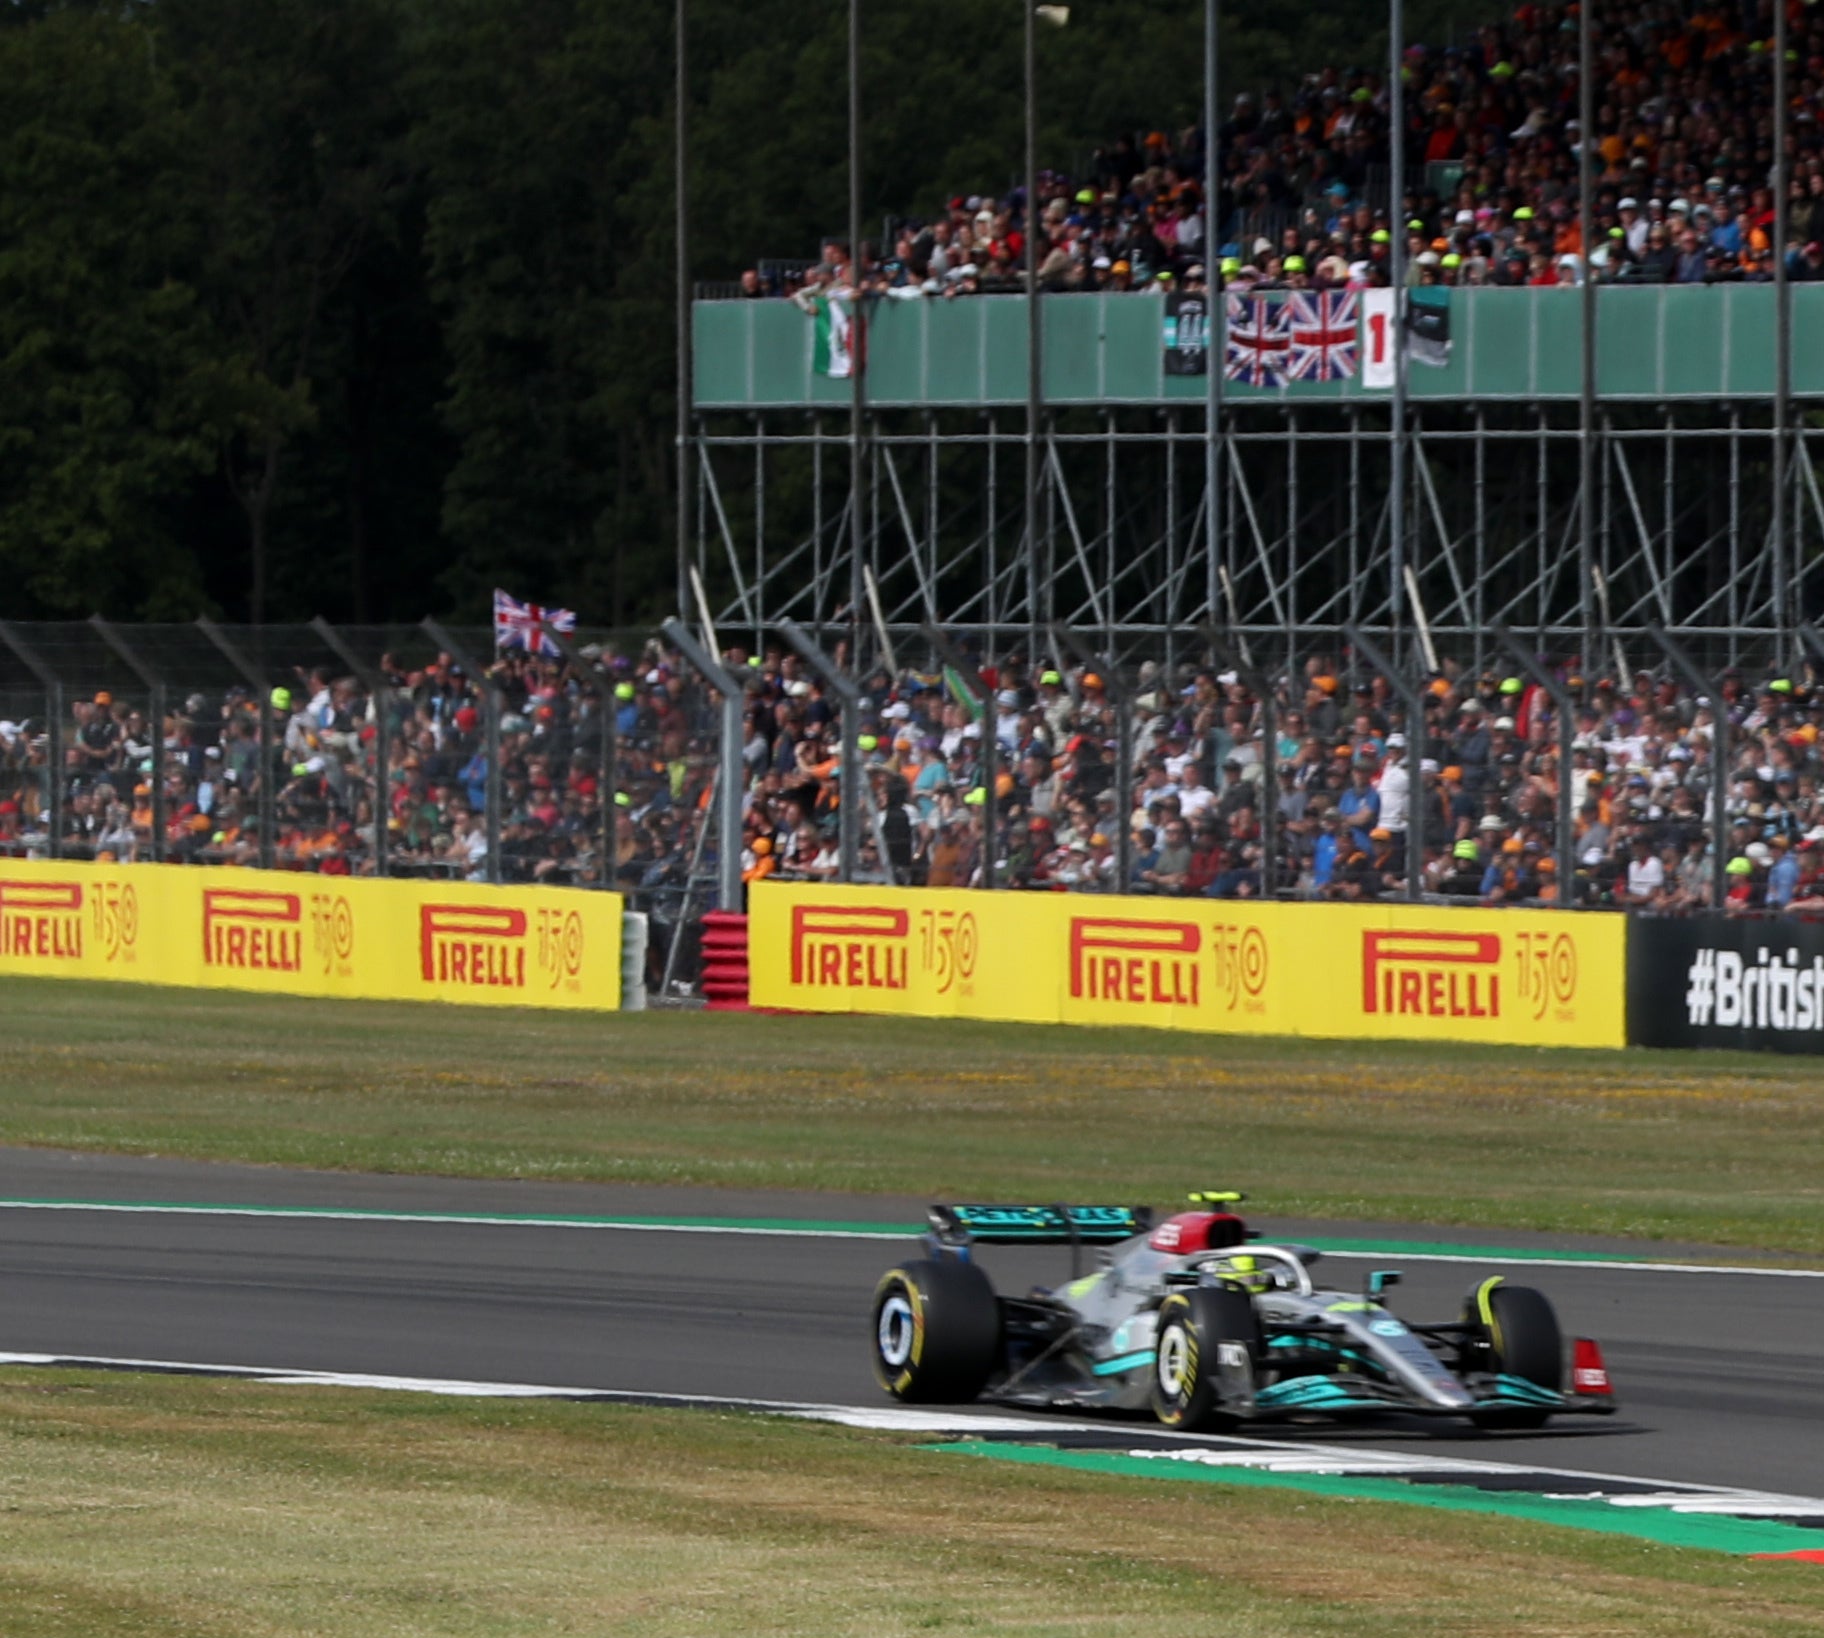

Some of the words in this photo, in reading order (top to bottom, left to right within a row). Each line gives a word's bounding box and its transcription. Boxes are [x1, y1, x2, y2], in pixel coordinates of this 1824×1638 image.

[0, 881, 82, 958] PIRELLI
[202, 888, 300, 971] PIRELLI
[420, 903, 526, 987] PIRELLI
[790, 905, 908, 989] PIRELLI
[1069, 917, 1200, 1006] PIRELLI
[1362, 929, 1500, 1017] PIRELLI
